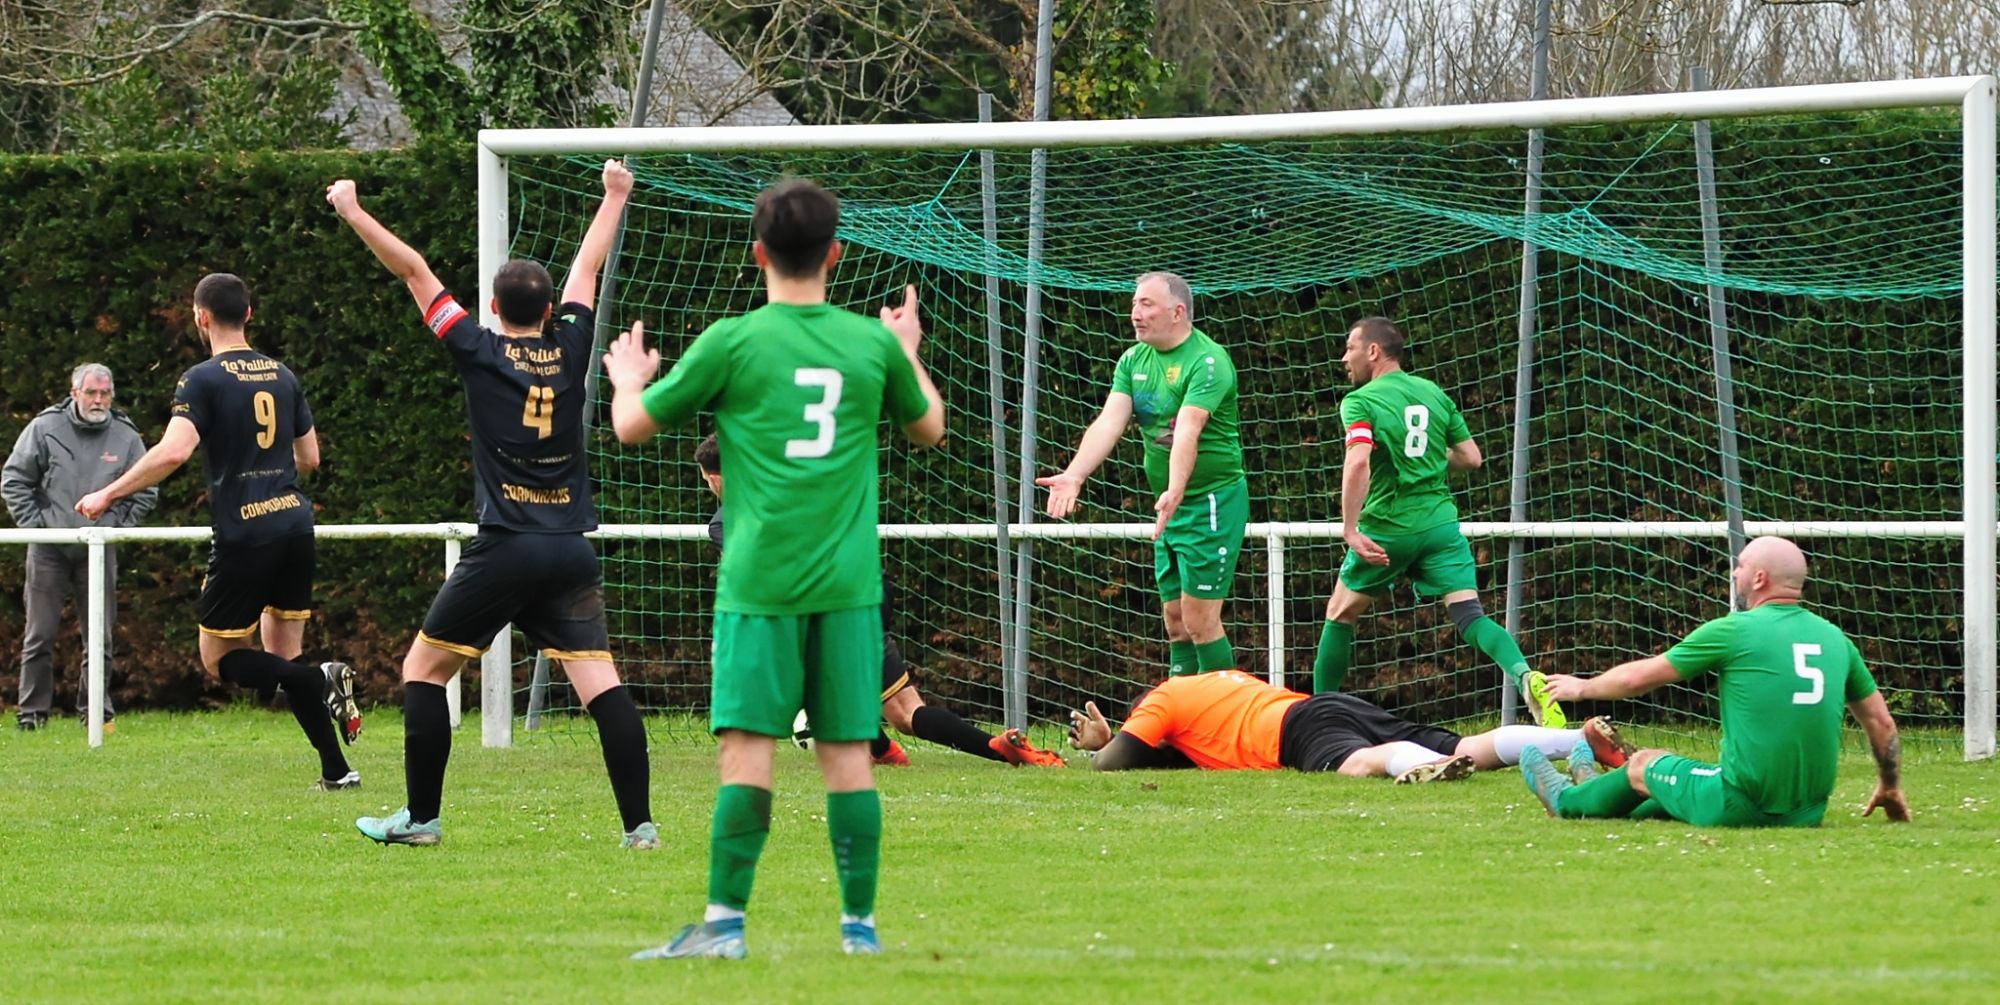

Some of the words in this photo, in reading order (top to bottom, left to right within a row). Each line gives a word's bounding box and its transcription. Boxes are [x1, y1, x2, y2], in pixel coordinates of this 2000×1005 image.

[220, 360, 239, 375] La
[253, 391, 277, 449] 9
[522, 385, 555, 440] 4
[784, 367, 844, 459] 3
[1404, 404, 1430, 459] 8
[240, 493, 301, 520] CORMORANS
[1791, 643, 1825, 705] 5
